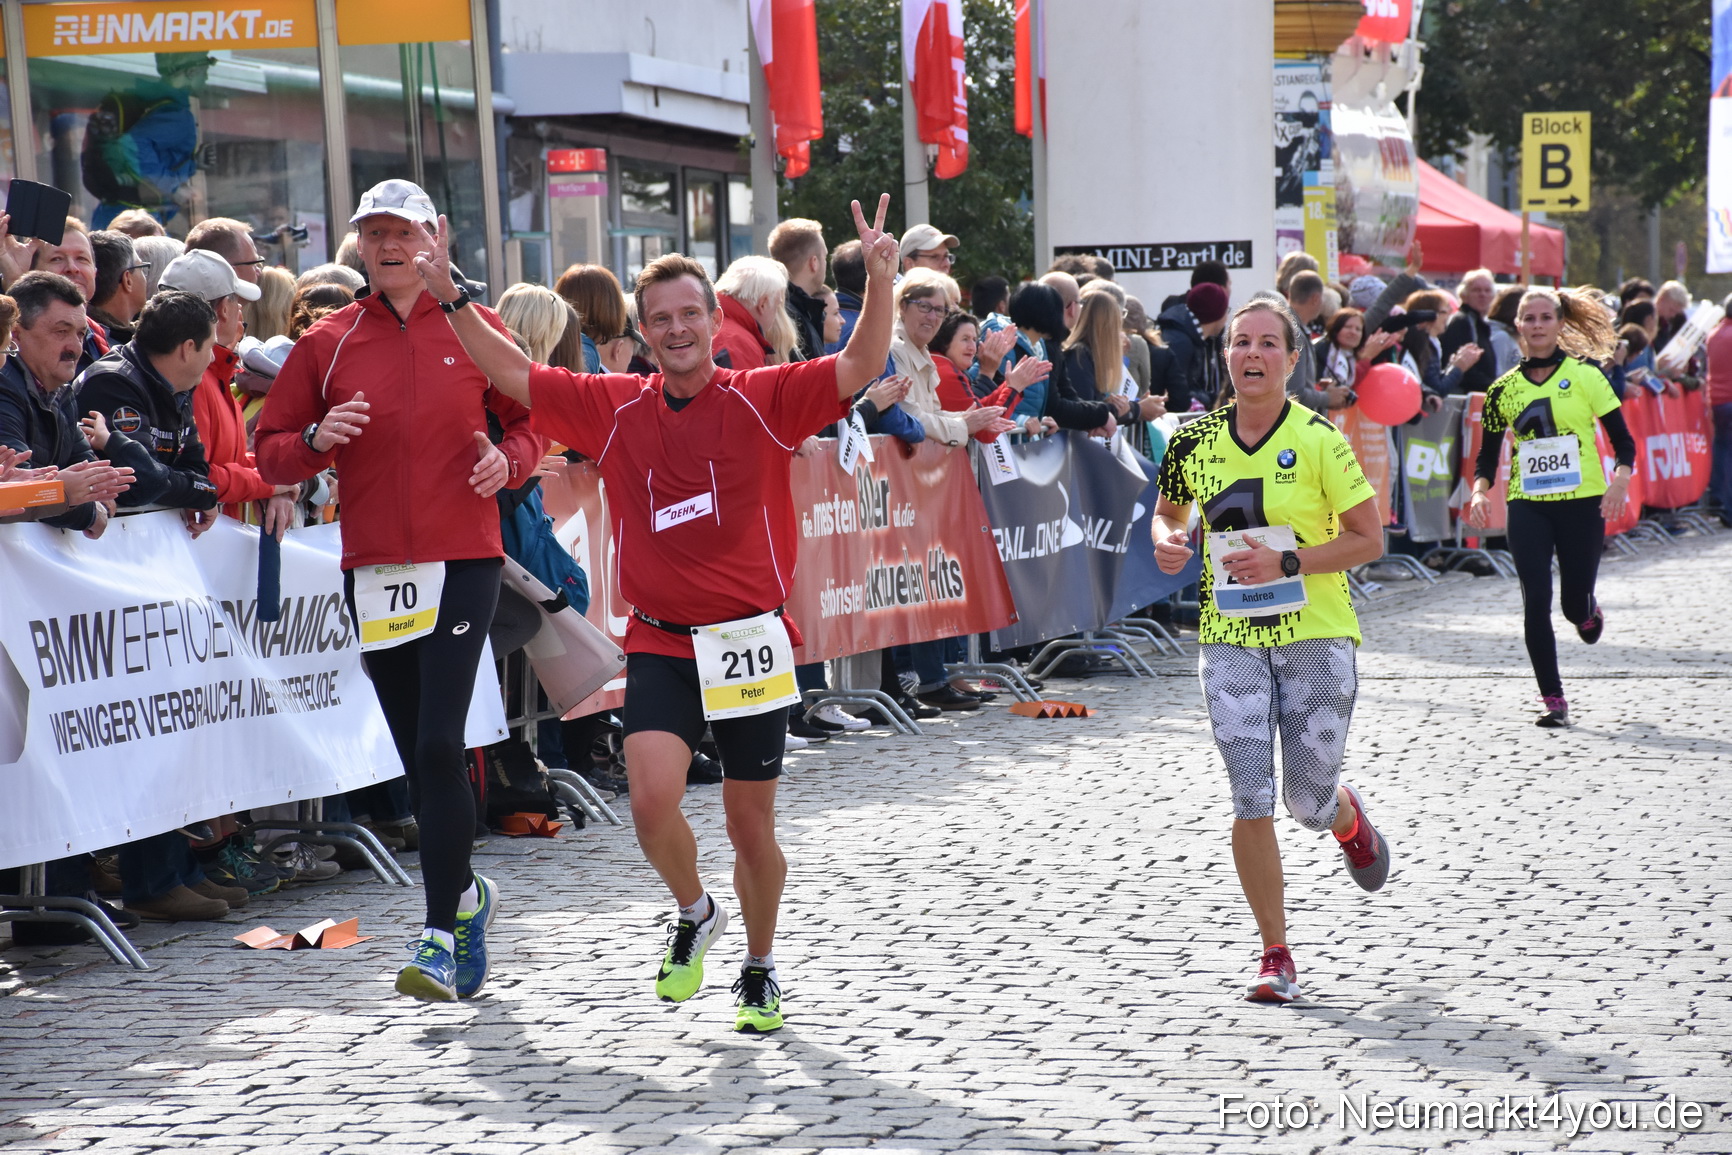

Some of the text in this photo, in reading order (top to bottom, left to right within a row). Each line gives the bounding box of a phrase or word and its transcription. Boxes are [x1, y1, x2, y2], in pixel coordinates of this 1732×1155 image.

[53, 9, 293, 46] RUNMARKT.DE
[1531, 117, 1583, 135] Block
[1540, 143, 1573, 190] B
[1527, 453, 1571, 474] 2684
[1535, 476, 1566, 485] Franziska
[670, 504, 696, 520] DEHN
[992, 518, 1061, 562] RAIL.ONE
[927, 547, 964, 601] Hits
[384, 582, 417, 612] 70
[1242, 591, 1274, 602] Andrea
[389, 618, 415, 632] Harald
[731, 625, 765, 639] BOCK
[29, 609, 115, 688] BMW
[721, 645, 774, 680] 219
[741, 687, 766, 699] Peter
[49, 699, 141, 755] WENIGER
[138, 679, 245, 737] VERBRAUCH.
